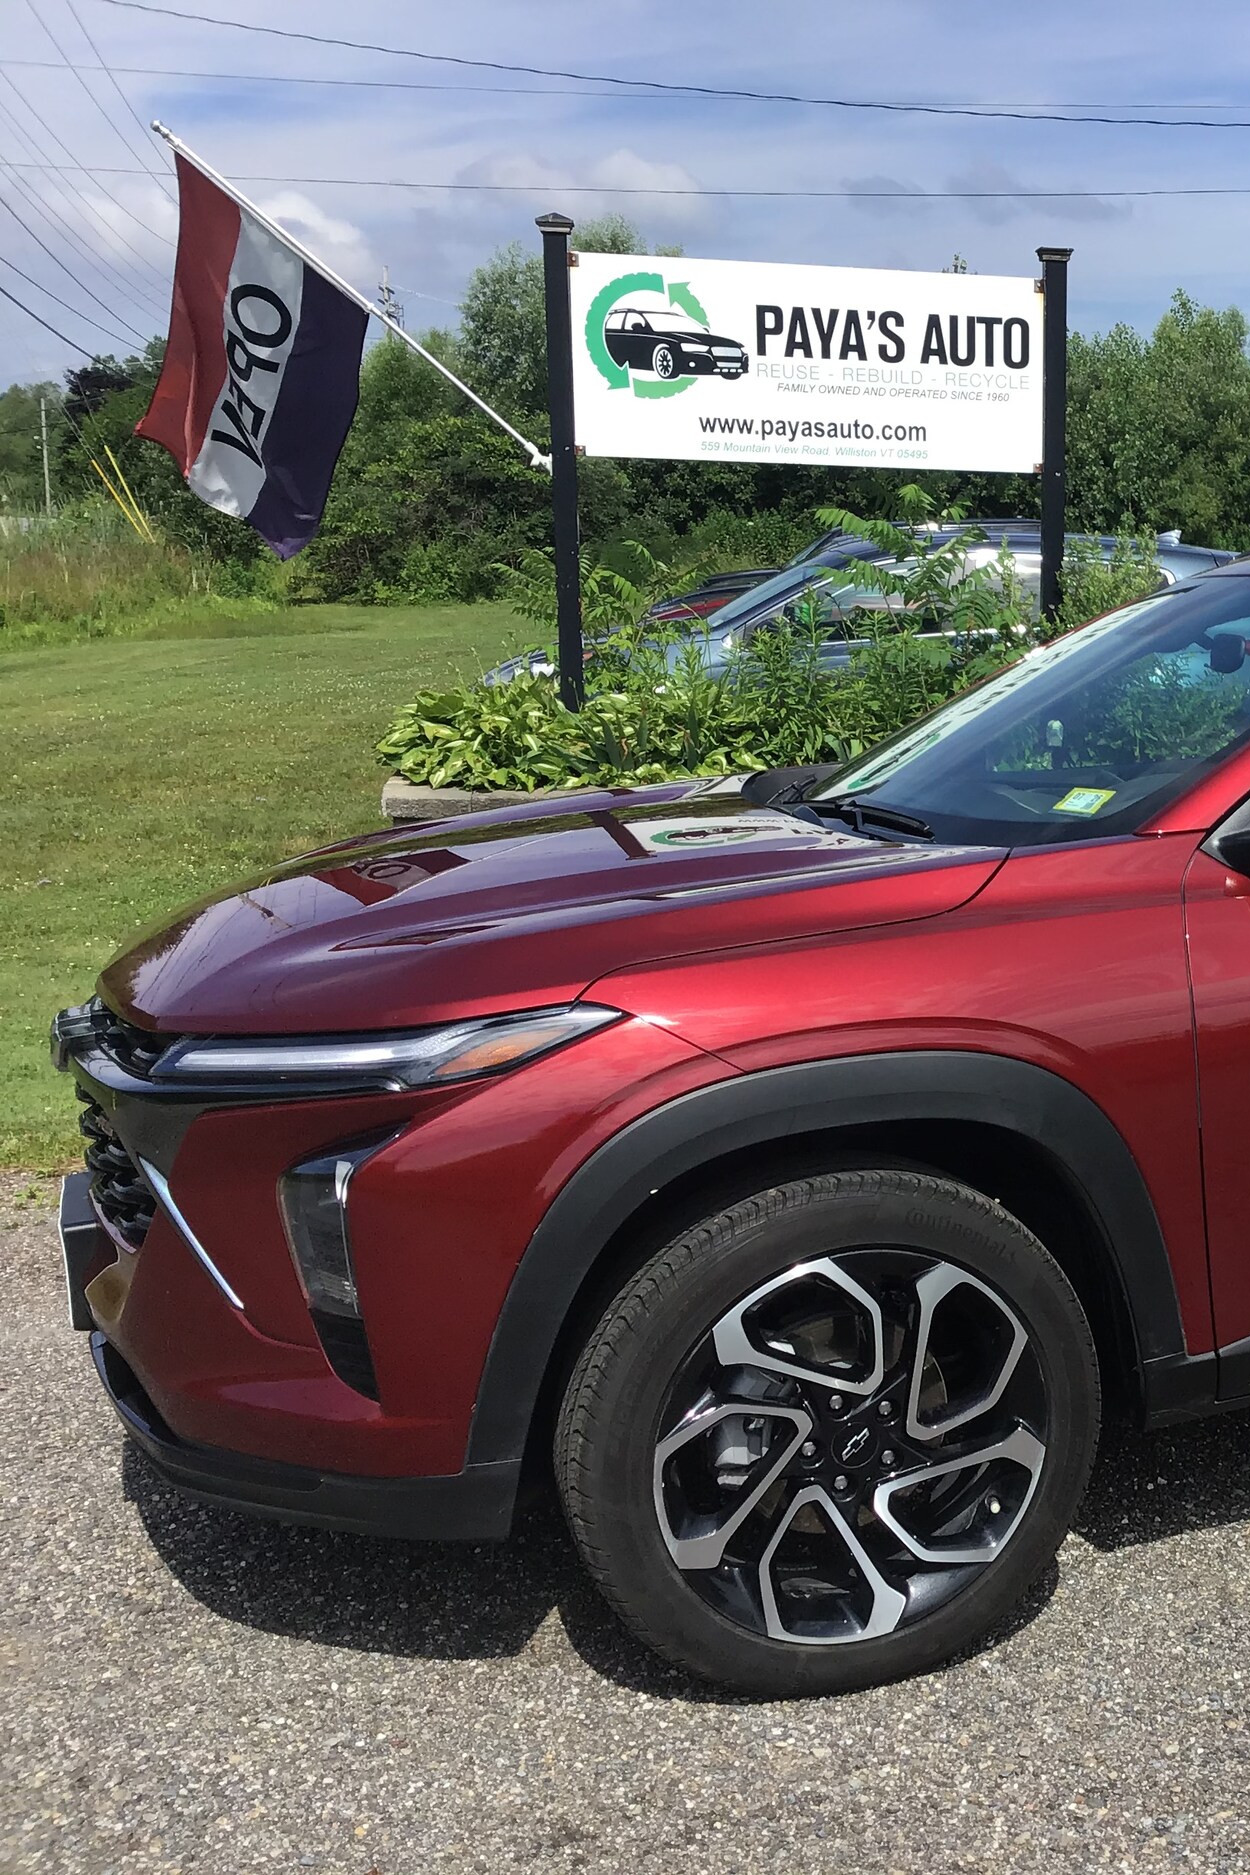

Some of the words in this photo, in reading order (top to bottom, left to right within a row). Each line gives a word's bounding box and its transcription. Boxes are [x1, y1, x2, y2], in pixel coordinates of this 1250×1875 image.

[756, 304, 906, 363] PAYA'S
[920, 314, 1030, 369] AUTO
[757, 363, 821, 380] REUSE
[843, 367, 923, 385] REBUILD
[945, 372, 1030, 390] RECYCLE
[777, 382, 816, 394] FAMILY
[819, 384, 861, 396] OWNED
[864, 387, 887, 397] AND
[890, 388, 948, 400] OPERATED
[951, 391, 983, 402] SINCE
[987, 393, 1010, 402] 1960
[698, 417, 927, 442] www.payasauto.com
[700, 441, 720, 451] 559
[724, 442, 771, 453] Mountain
[774, 445, 799, 454] View
[835, 447, 877, 458] Williston
[880, 449, 894, 458] VT
[897, 450, 928, 460] 05495
